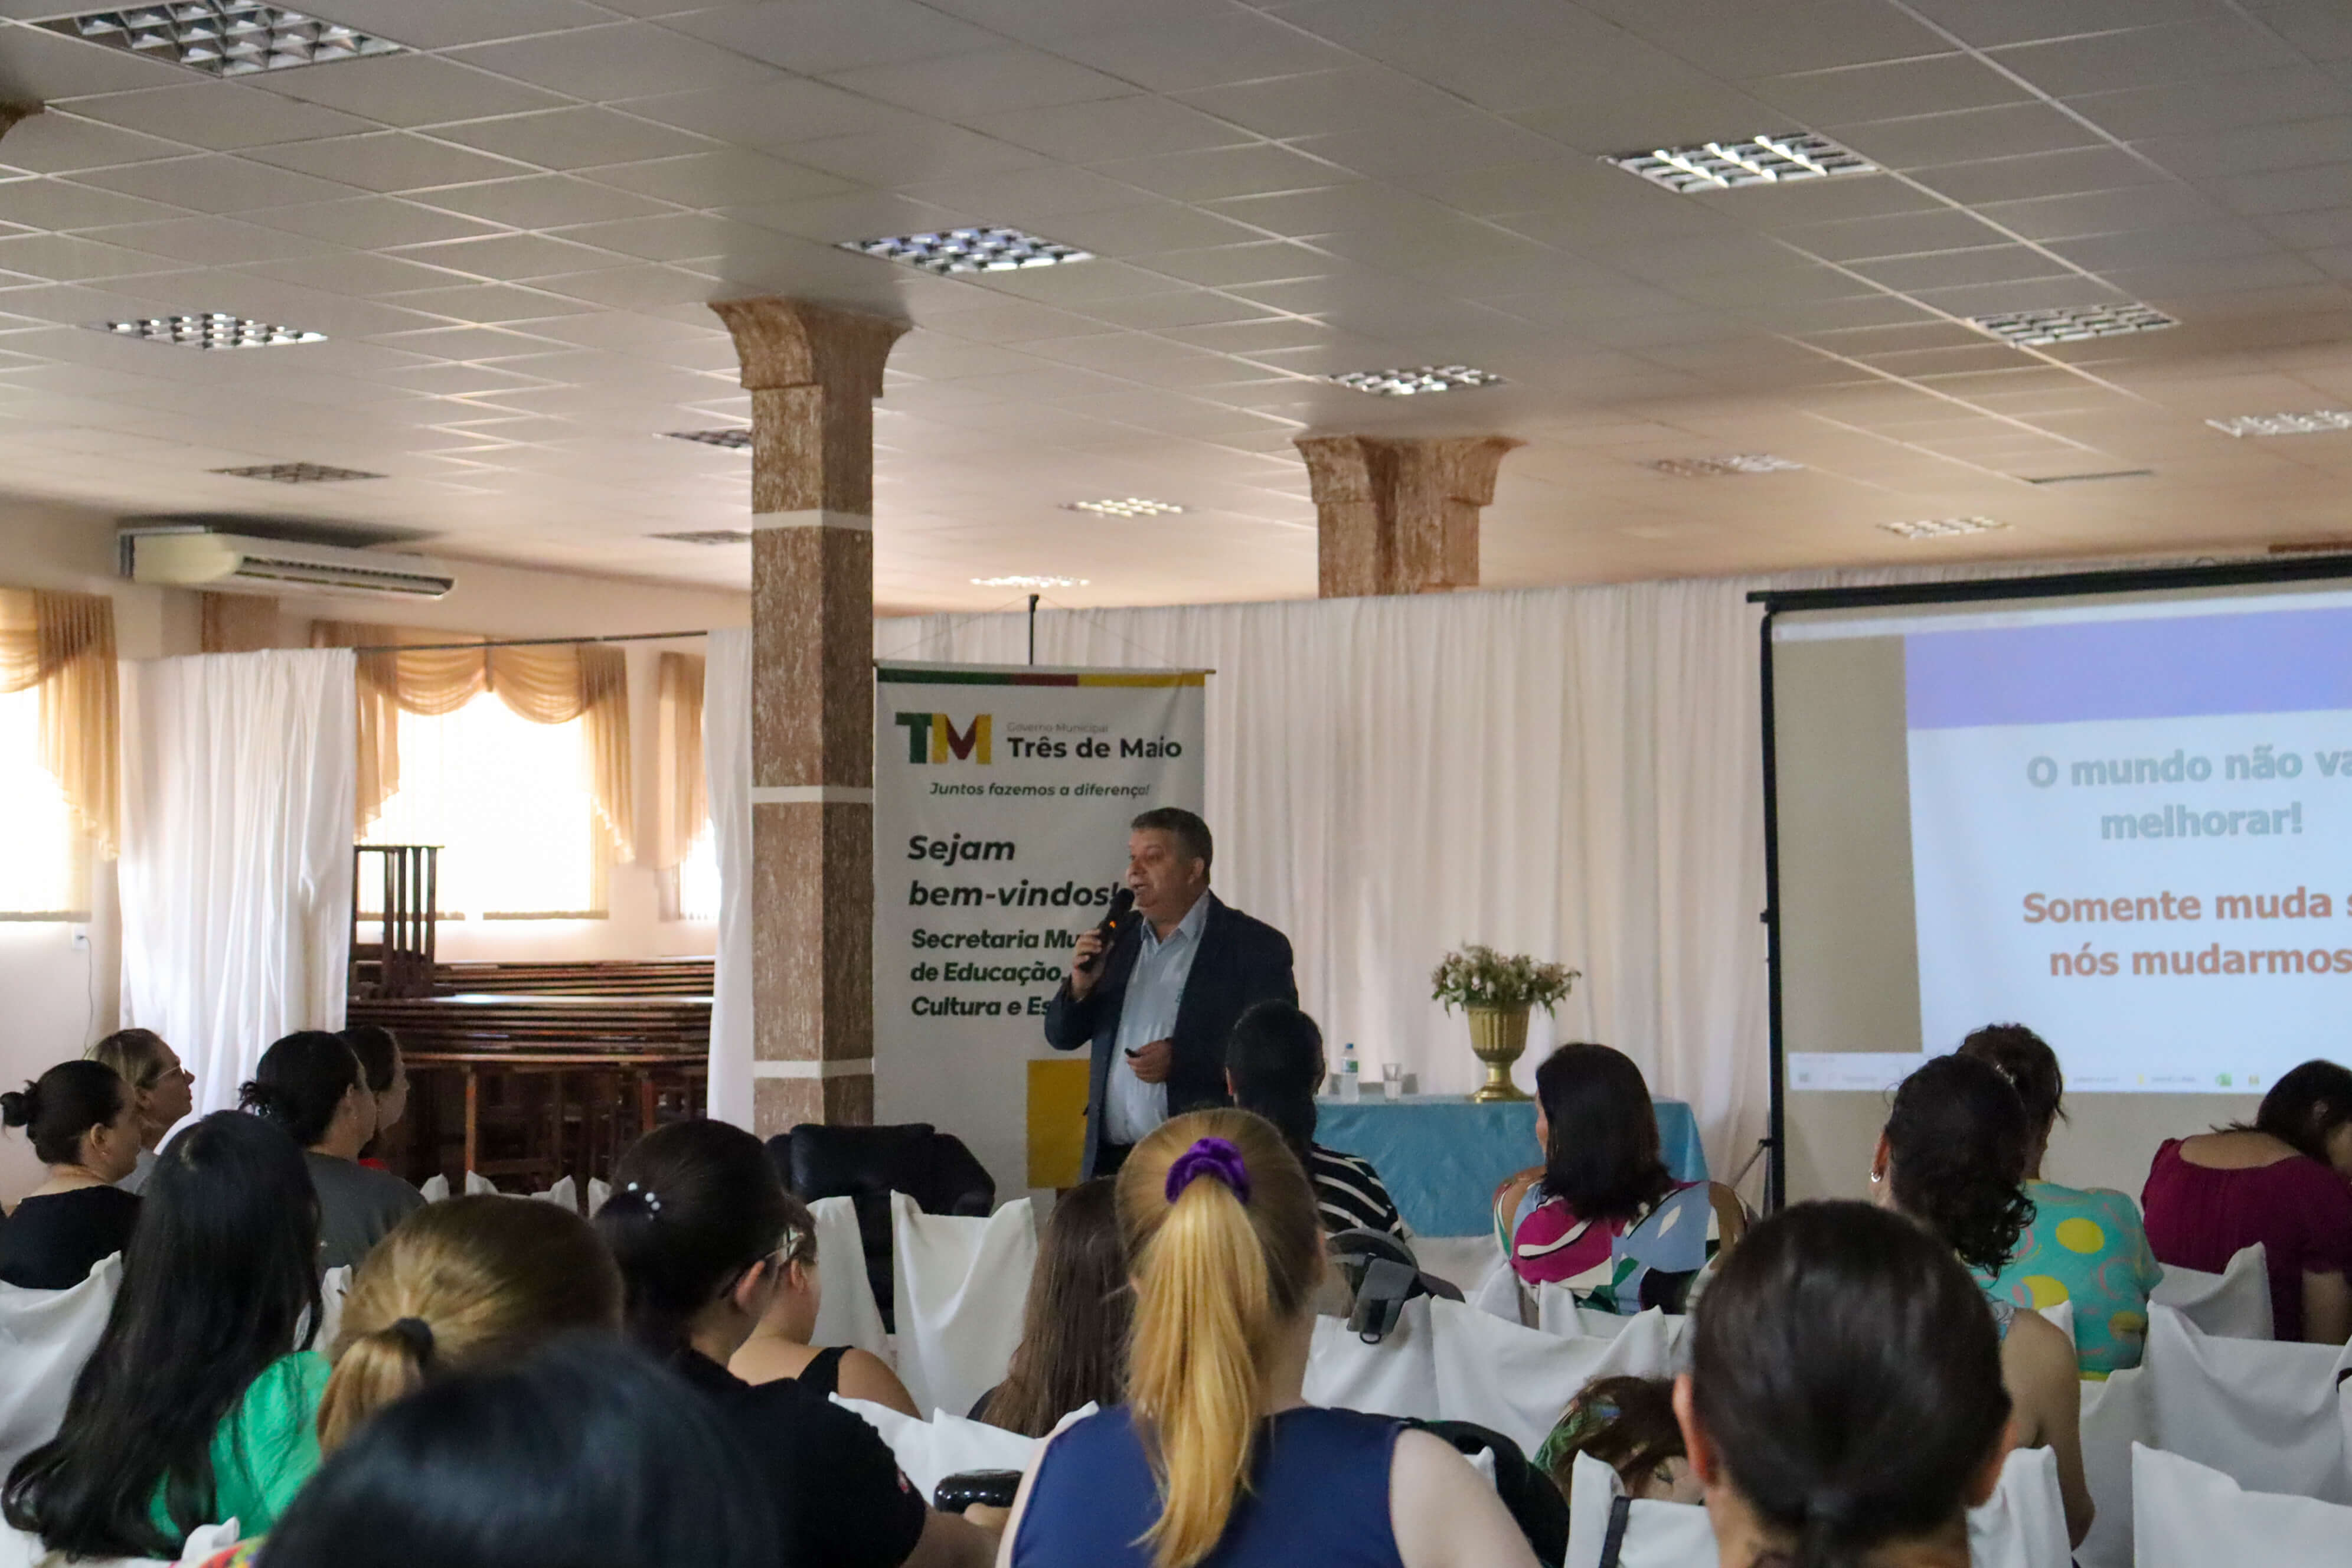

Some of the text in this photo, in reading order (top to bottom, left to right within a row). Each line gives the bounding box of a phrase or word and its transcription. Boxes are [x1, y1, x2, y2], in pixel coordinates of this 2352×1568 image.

[1006, 723, 1108, 734] Governo Municipal
[1007, 735, 1182, 758] Três de Maio
[2027, 755, 2059, 788] O
[2070, 749, 2212, 786] mundo
[2225, 744, 2303, 780] não
[929, 782, 1150, 798] Juntos fazemos a diferença!
[2101, 802, 2303, 840] melhorar!
[907, 832, 1015, 867] Sejam
[2022, 890, 2201, 924] Somente
[2215, 886, 2332, 919] muda
[912, 929, 1039, 949] Secretaria
[2049, 942, 2352, 978] nós mudarmos
[910, 962, 938, 982] de
[911, 997, 1002, 1017] Cultura
[1007, 1001, 1021, 1016] e
